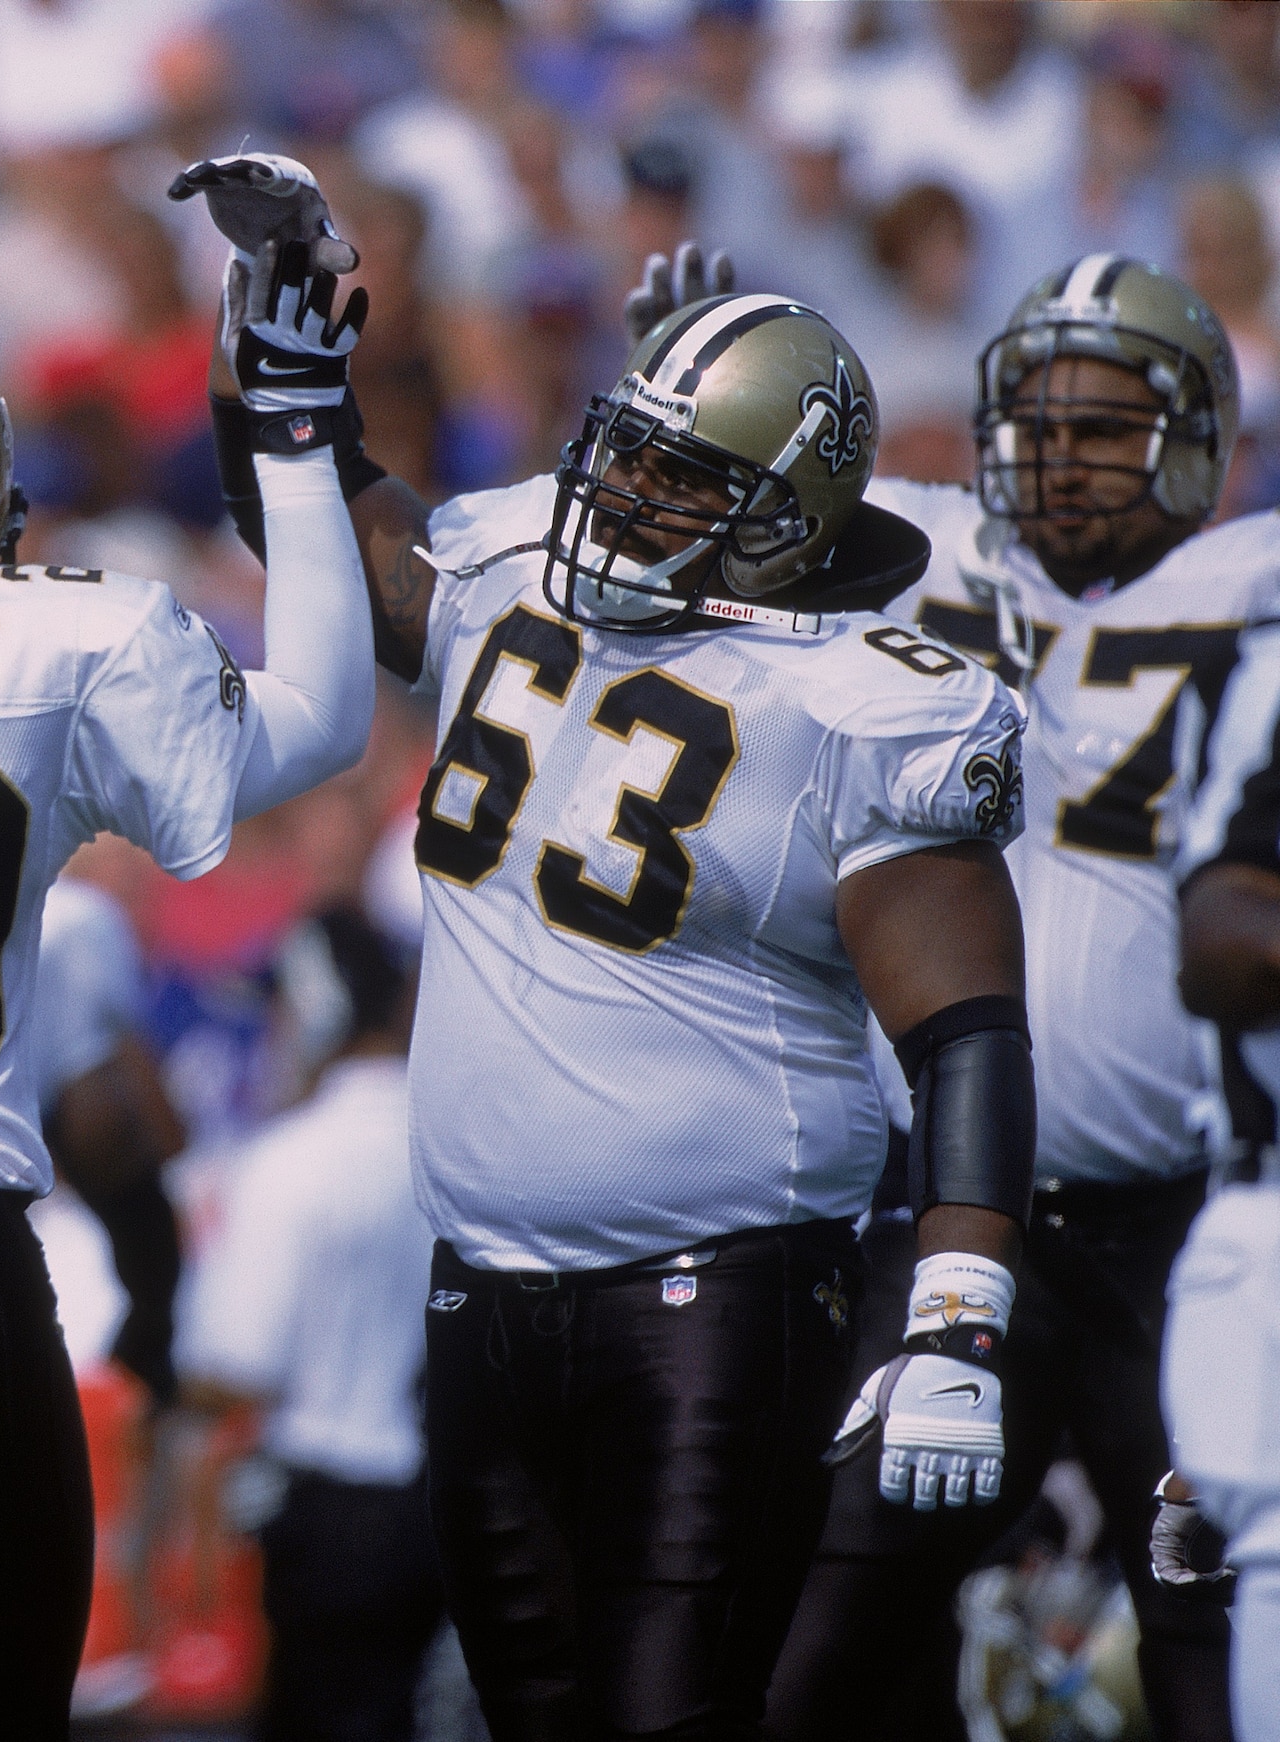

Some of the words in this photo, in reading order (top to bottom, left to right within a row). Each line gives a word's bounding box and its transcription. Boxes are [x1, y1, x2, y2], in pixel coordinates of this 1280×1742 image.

[695, 597, 754, 621] Riddell
[862, 625, 968, 677] 6
[414, 601, 741, 957] 63
